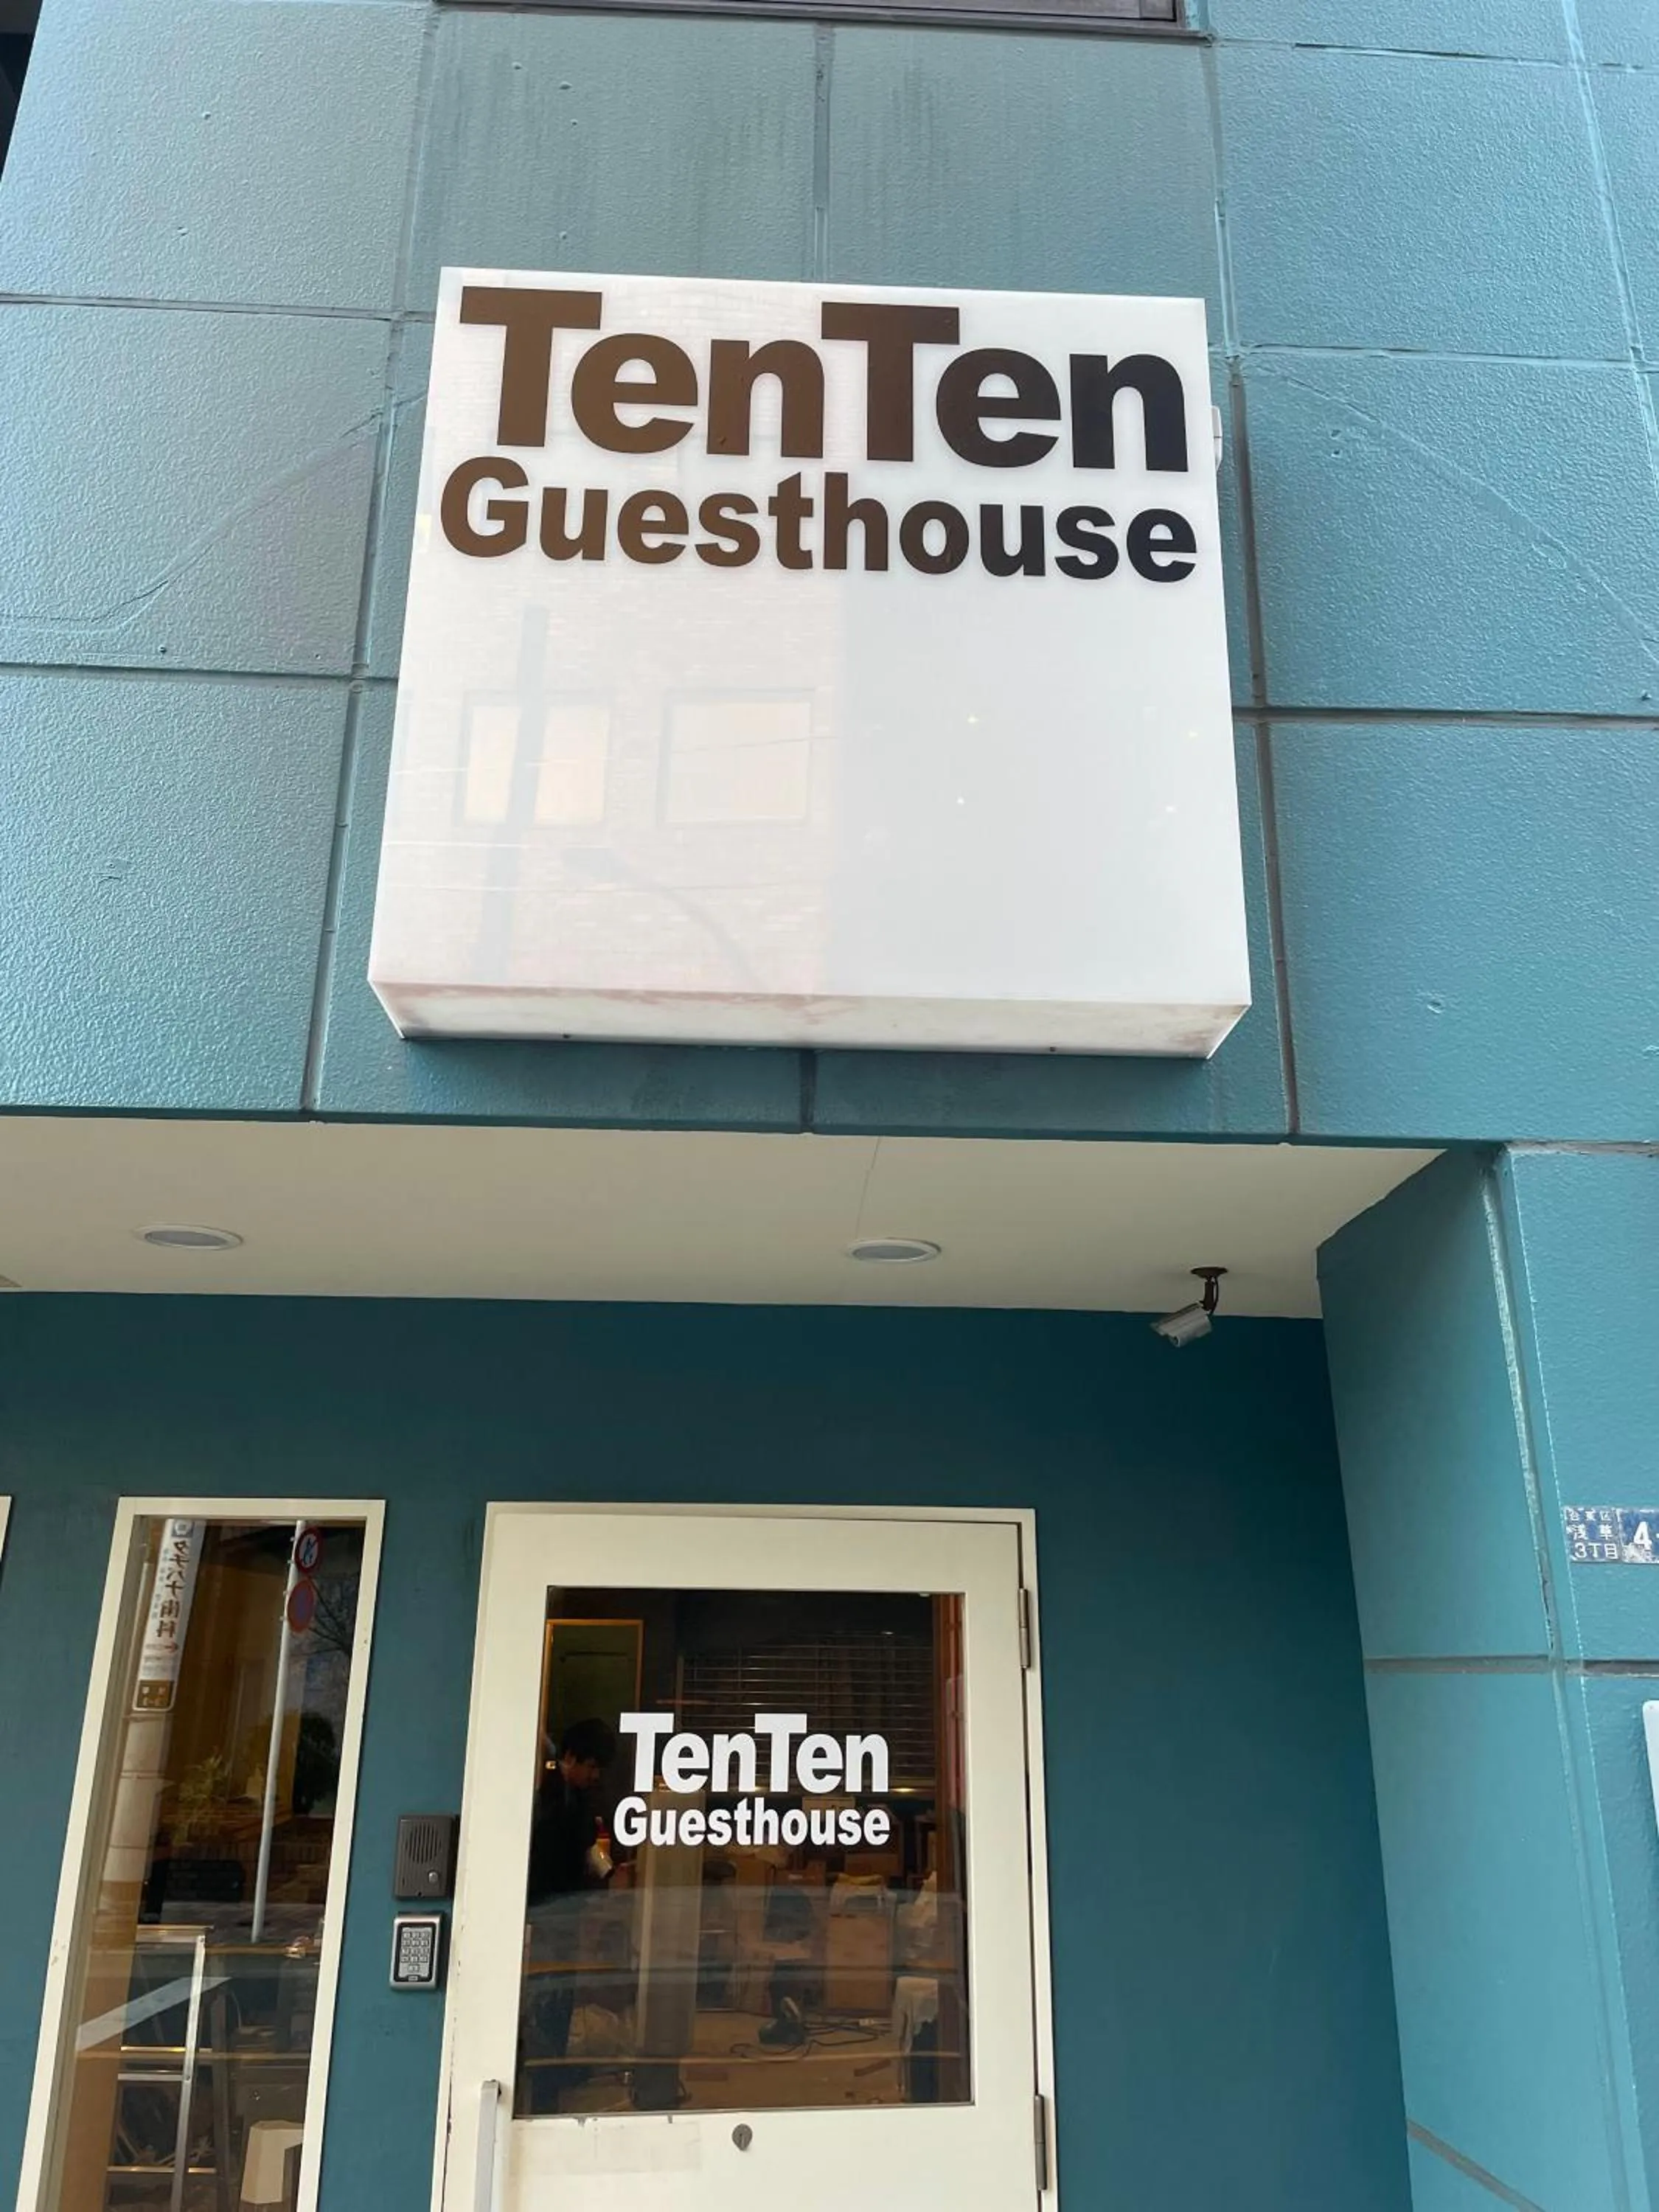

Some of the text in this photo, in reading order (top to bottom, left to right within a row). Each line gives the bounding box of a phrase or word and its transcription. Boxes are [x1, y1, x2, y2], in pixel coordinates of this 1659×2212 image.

[459, 285, 1189, 473] TenTen
[440, 455, 1197, 584] Guesthouse
[619, 1712, 889, 1794] TenTen
[613, 1795, 891, 1846] Guesthouse
